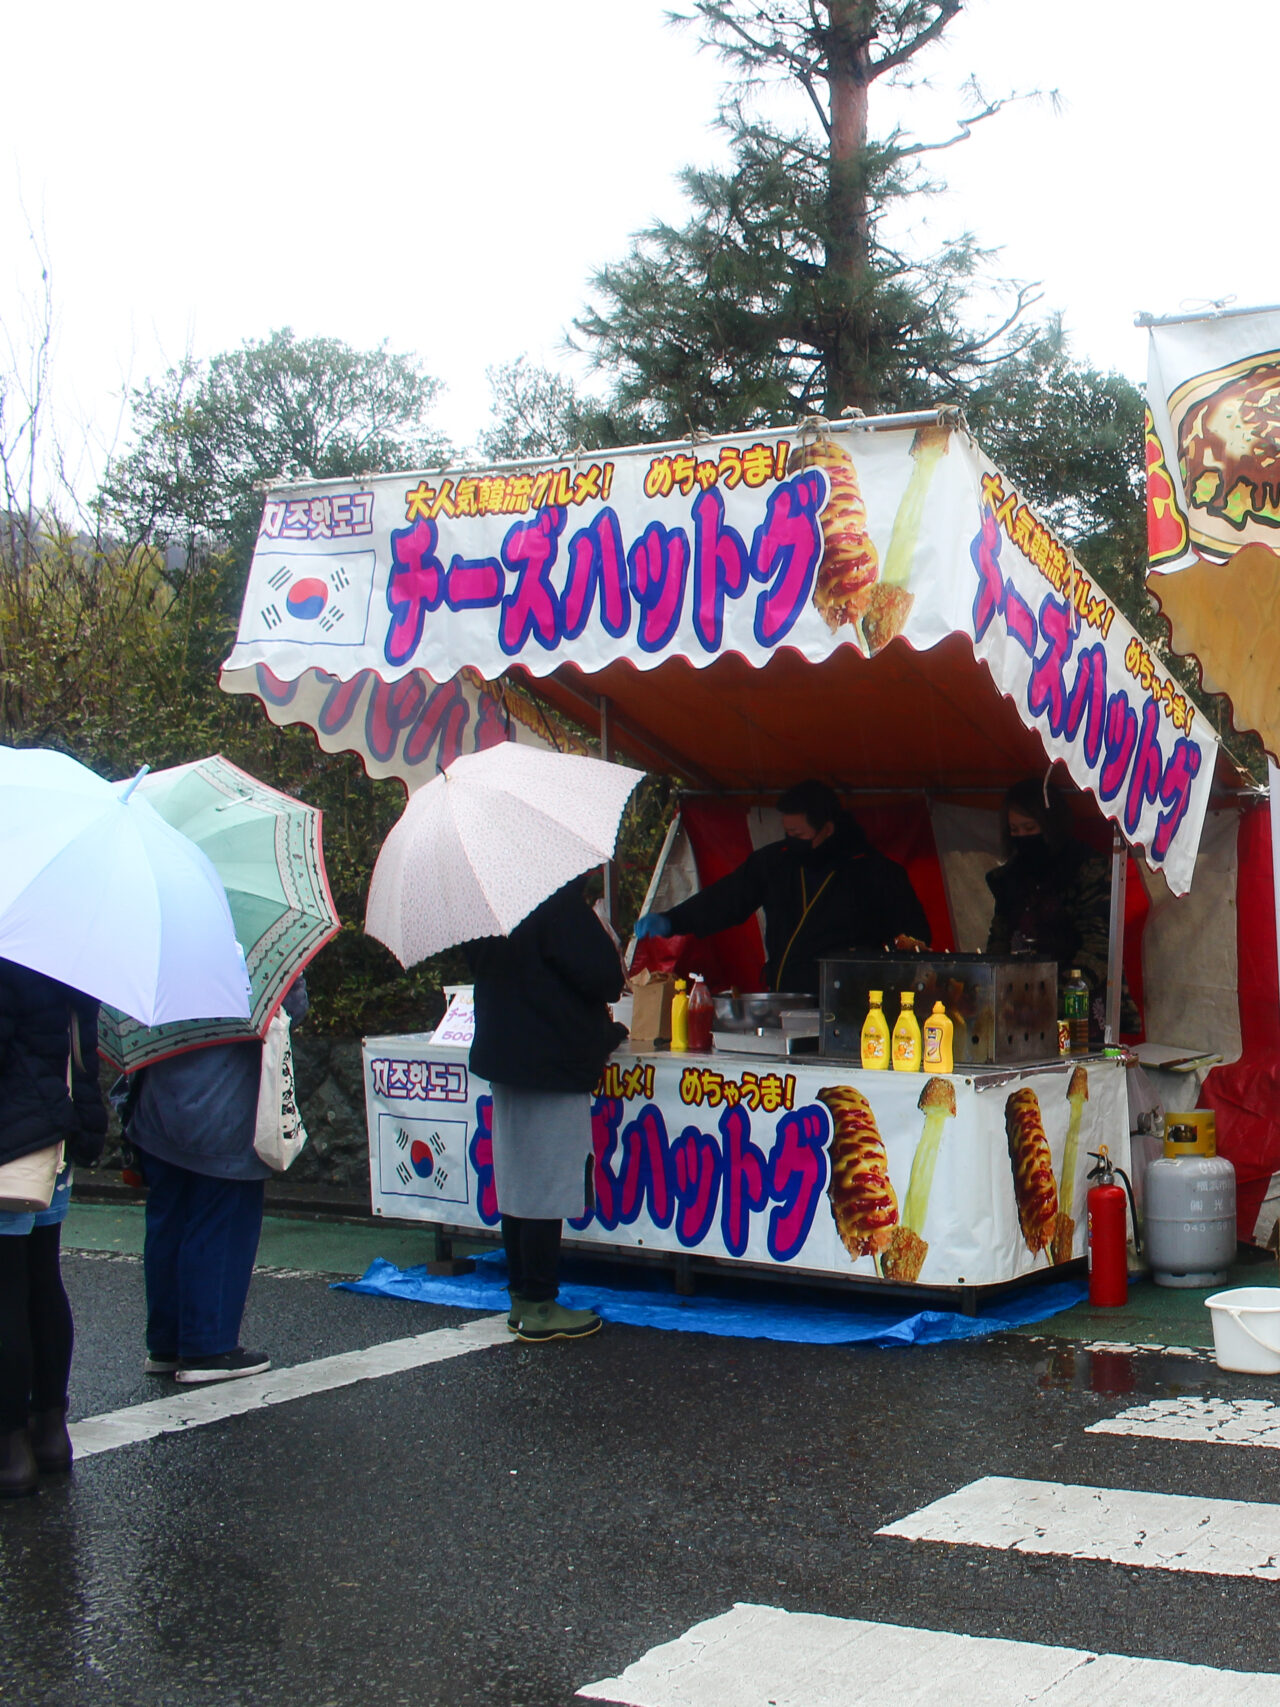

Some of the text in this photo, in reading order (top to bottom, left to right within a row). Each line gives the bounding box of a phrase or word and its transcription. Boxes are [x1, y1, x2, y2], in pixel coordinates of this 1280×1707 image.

[405, 441, 790, 521] 大人気韓流グルメ! めちゃうま!
[384, 470, 827, 666] チーズハットグ
[1124, 638, 1195, 737] めちゃうま!
[680, 1068, 796, 1112] めちゃうま!
